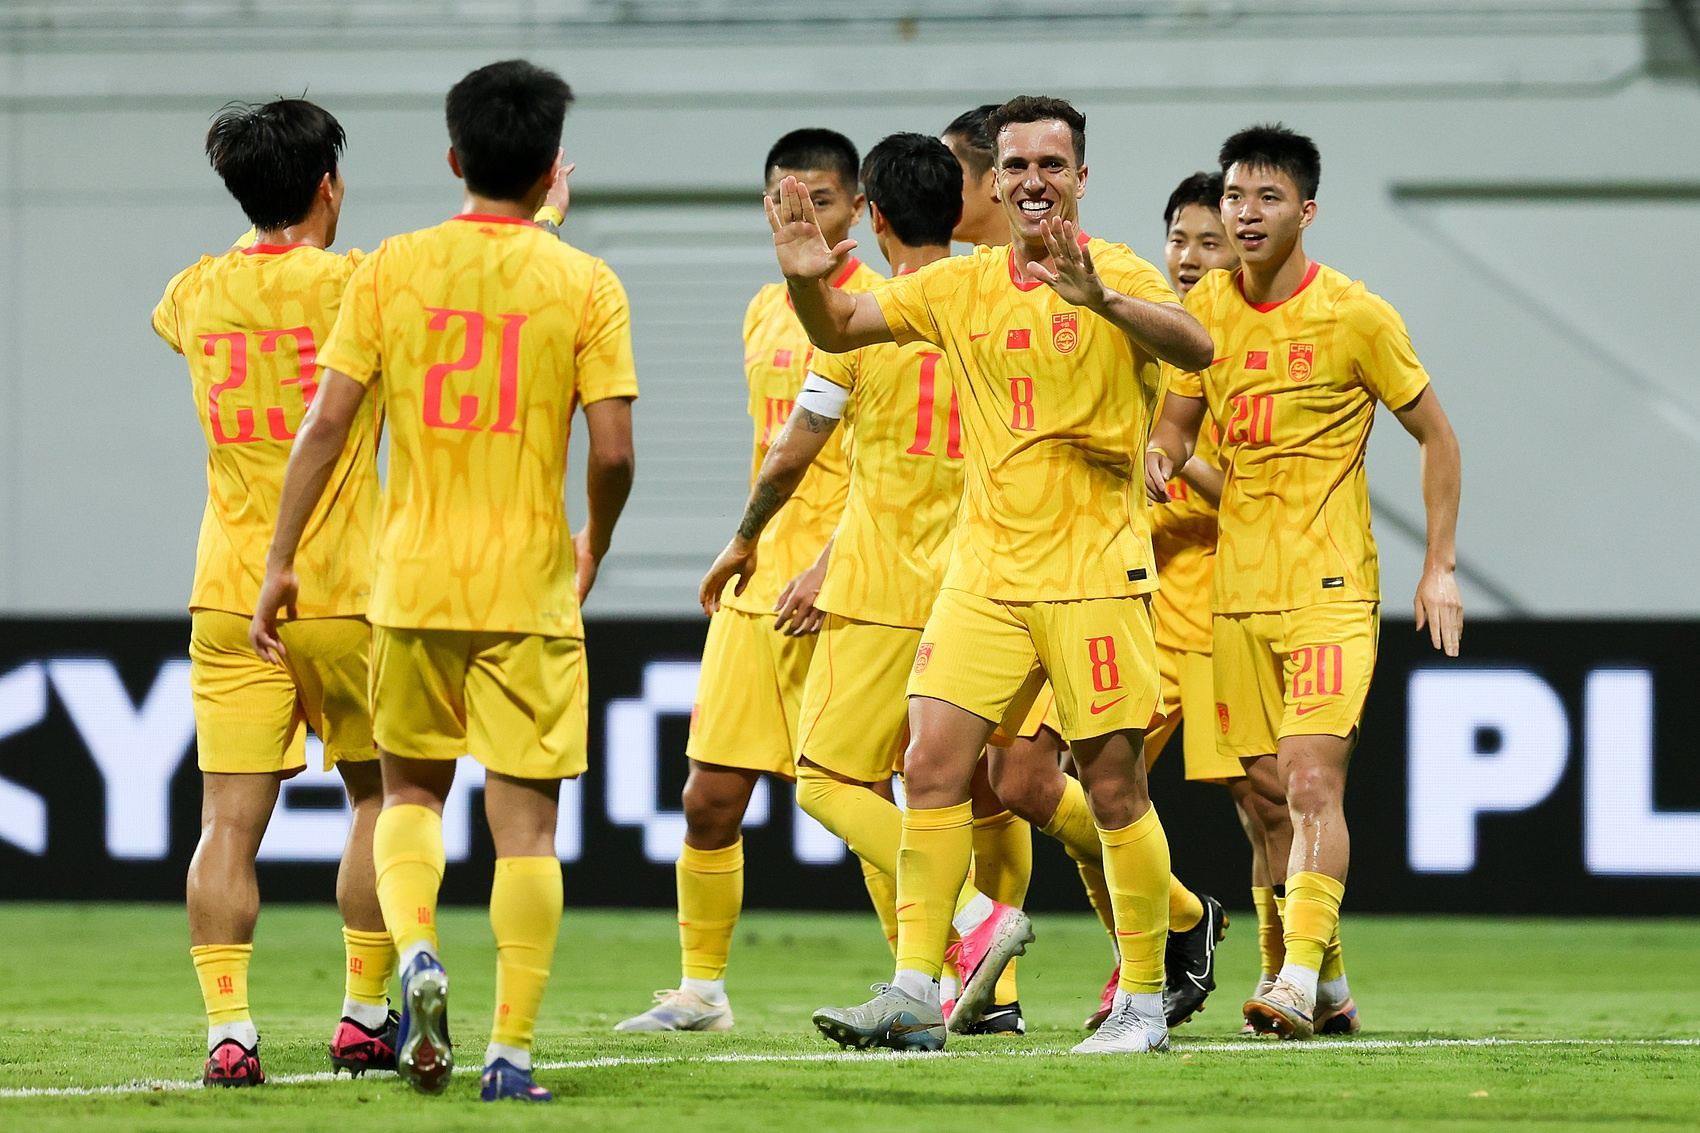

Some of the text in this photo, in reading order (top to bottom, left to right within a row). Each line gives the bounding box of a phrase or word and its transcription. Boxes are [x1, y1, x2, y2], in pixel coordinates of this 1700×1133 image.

[1052, 313, 1076, 324] CFA
[197, 326, 318, 444] 23
[423, 307, 528, 434] 21
[1007, 376, 1037, 431] 8
[1228, 394, 1276, 446] 20
[1085, 635, 1123, 692] 8
[1290, 644, 1344, 698] 20
[1406, 667, 1700, 875] PL
